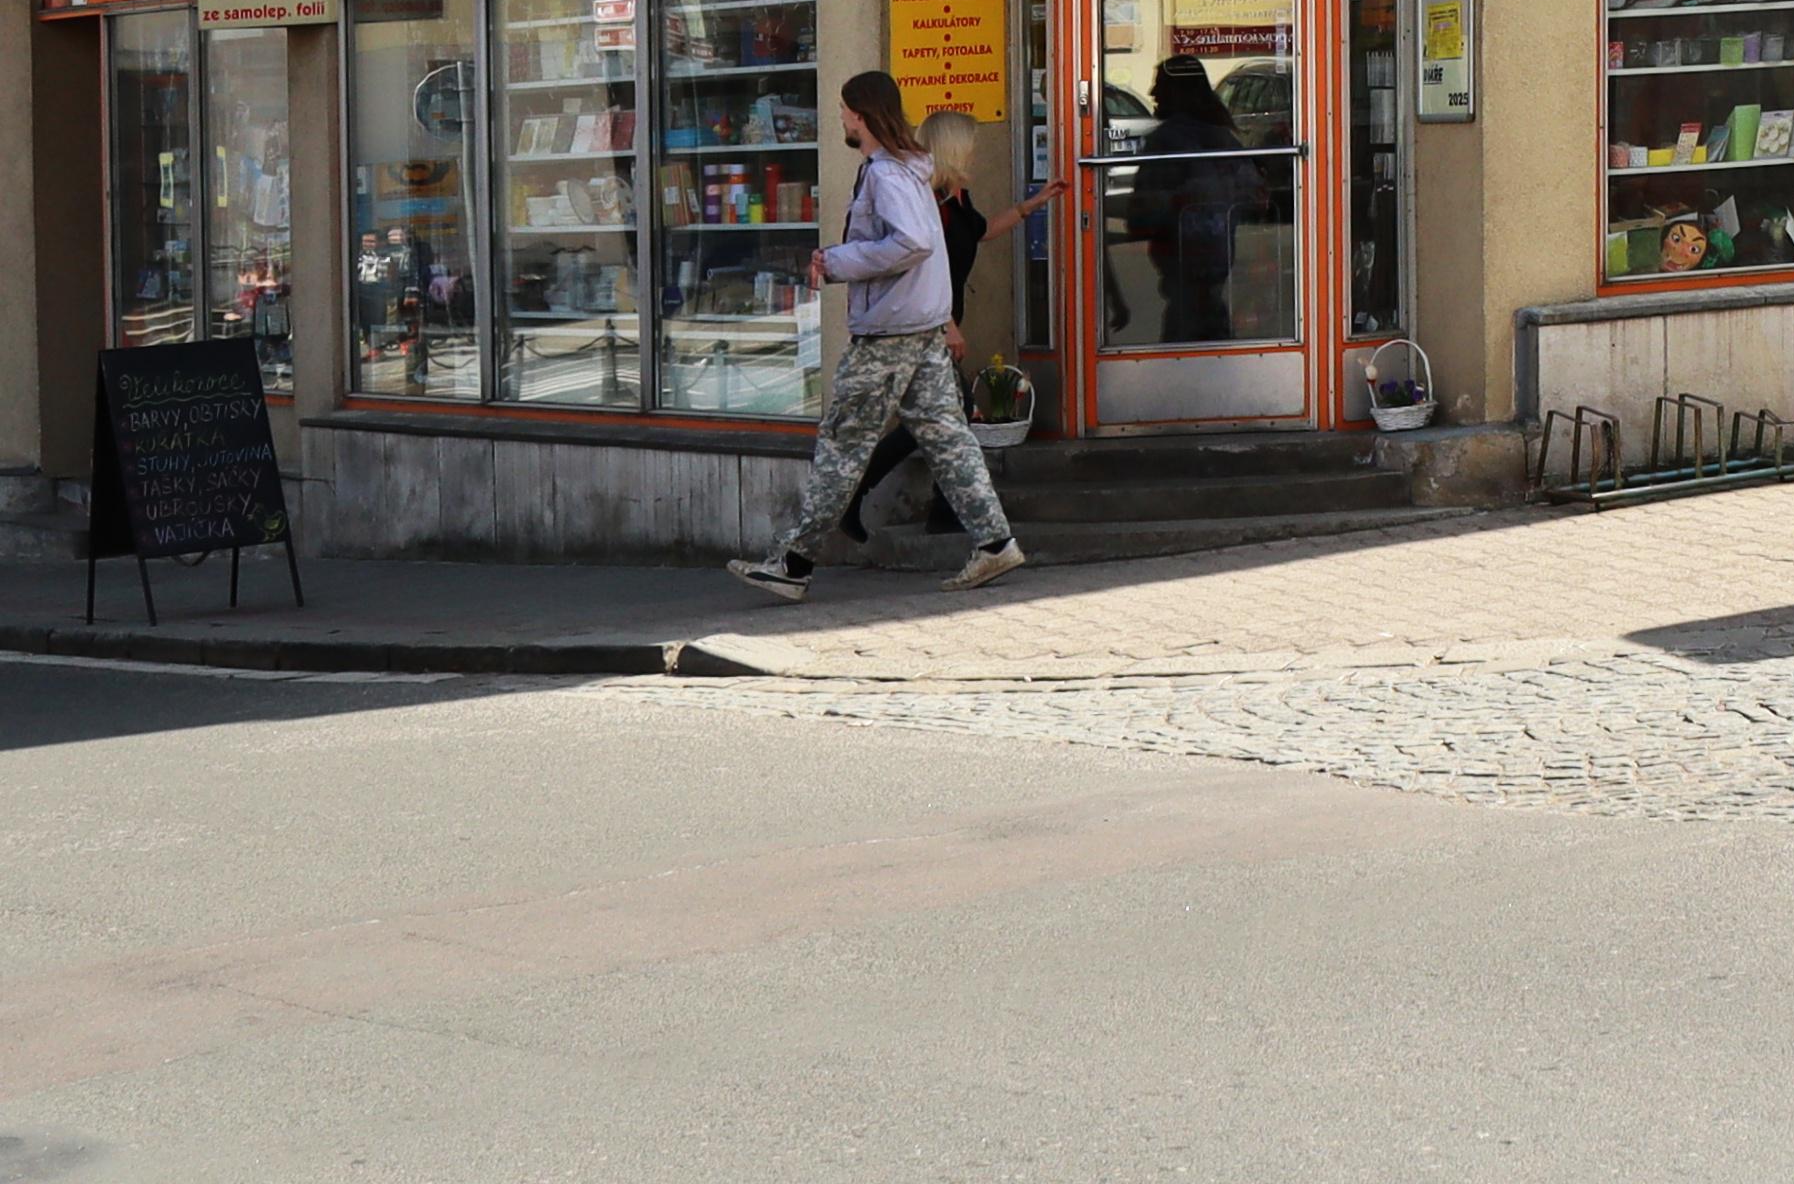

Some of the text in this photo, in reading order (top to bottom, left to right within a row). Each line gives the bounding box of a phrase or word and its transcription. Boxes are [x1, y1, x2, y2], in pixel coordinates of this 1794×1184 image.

[203, 9, 220, 22] ze
[224, 4, 292, 21] samolep.
[912, 14, 981, 30] KALKULÁTORY
[942, 44, 993, 57] FOTOALBA
[949, 71, 1000, 85] DEKORACE
[1447, 91, 1469, 107] 2025
